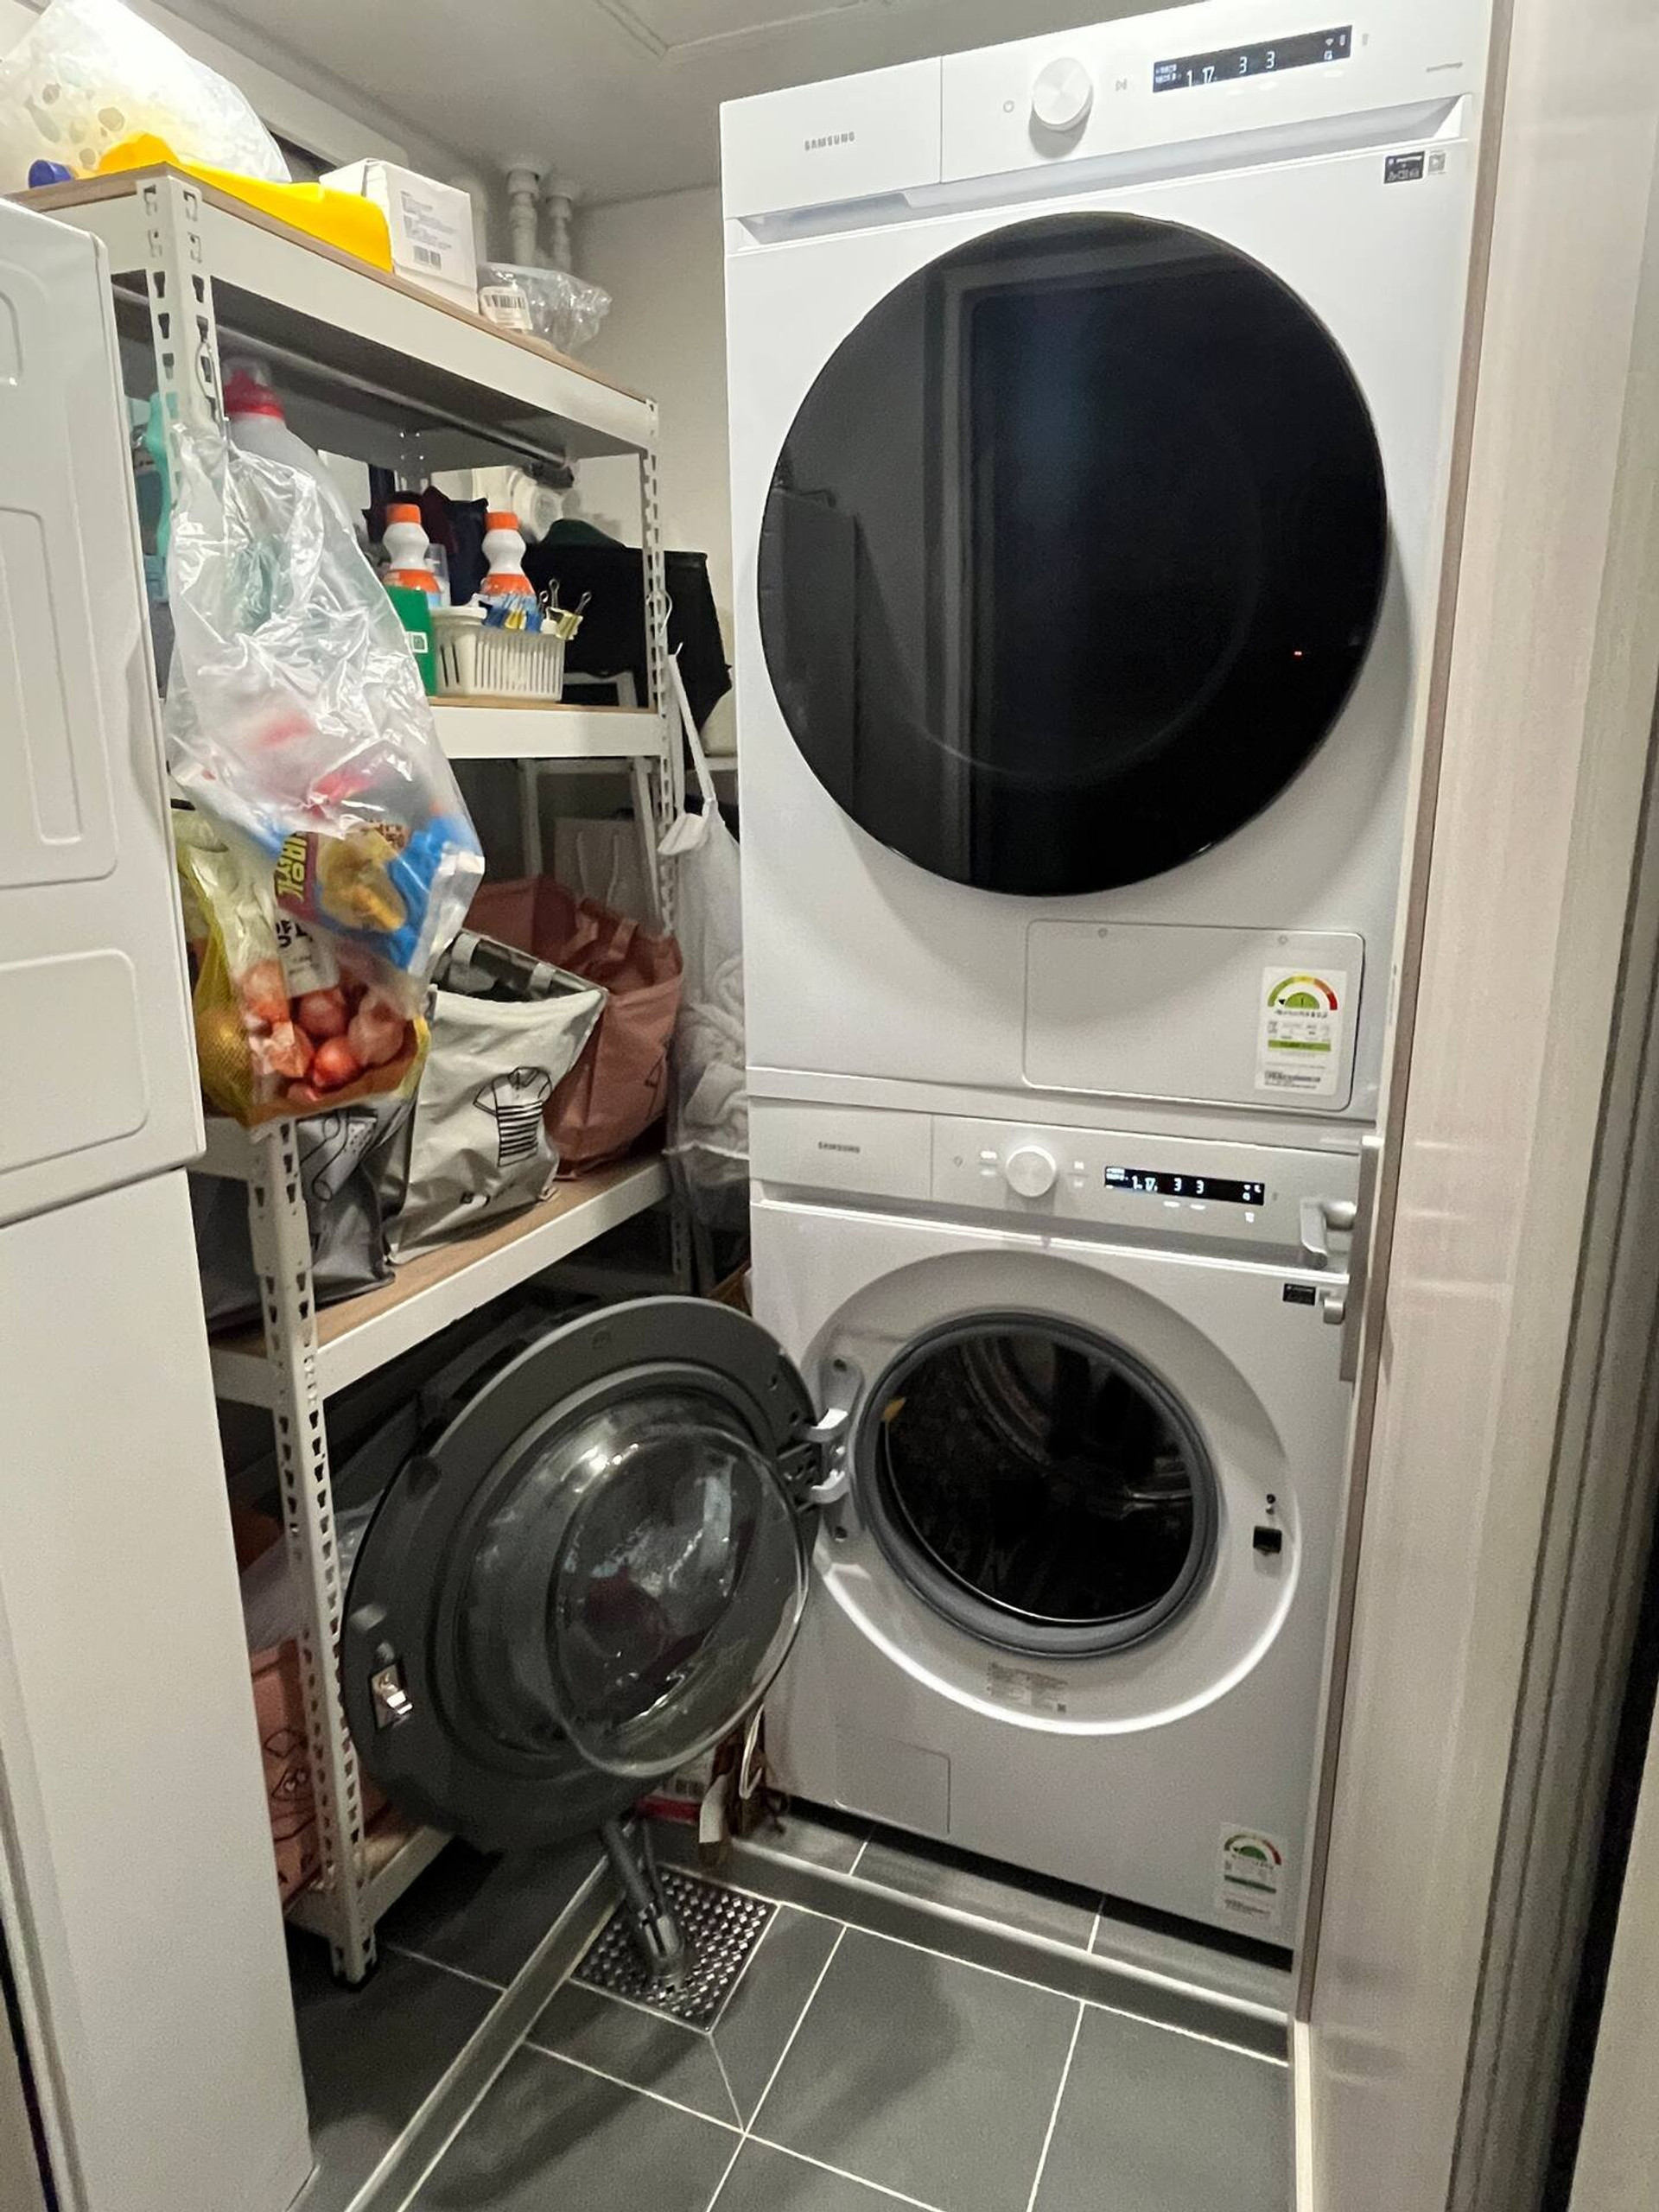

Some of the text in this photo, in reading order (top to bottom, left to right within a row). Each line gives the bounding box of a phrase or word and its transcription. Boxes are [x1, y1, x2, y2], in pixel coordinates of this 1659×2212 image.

[1239, 56, 1248, 73] 3
[1265, 51, 1275, 68] 3
[804, 131, 855, 150] SAMSUNG
[1174, 1178, 1183, 1192] 3
[1196, 1180, 1205, 1194] 3
